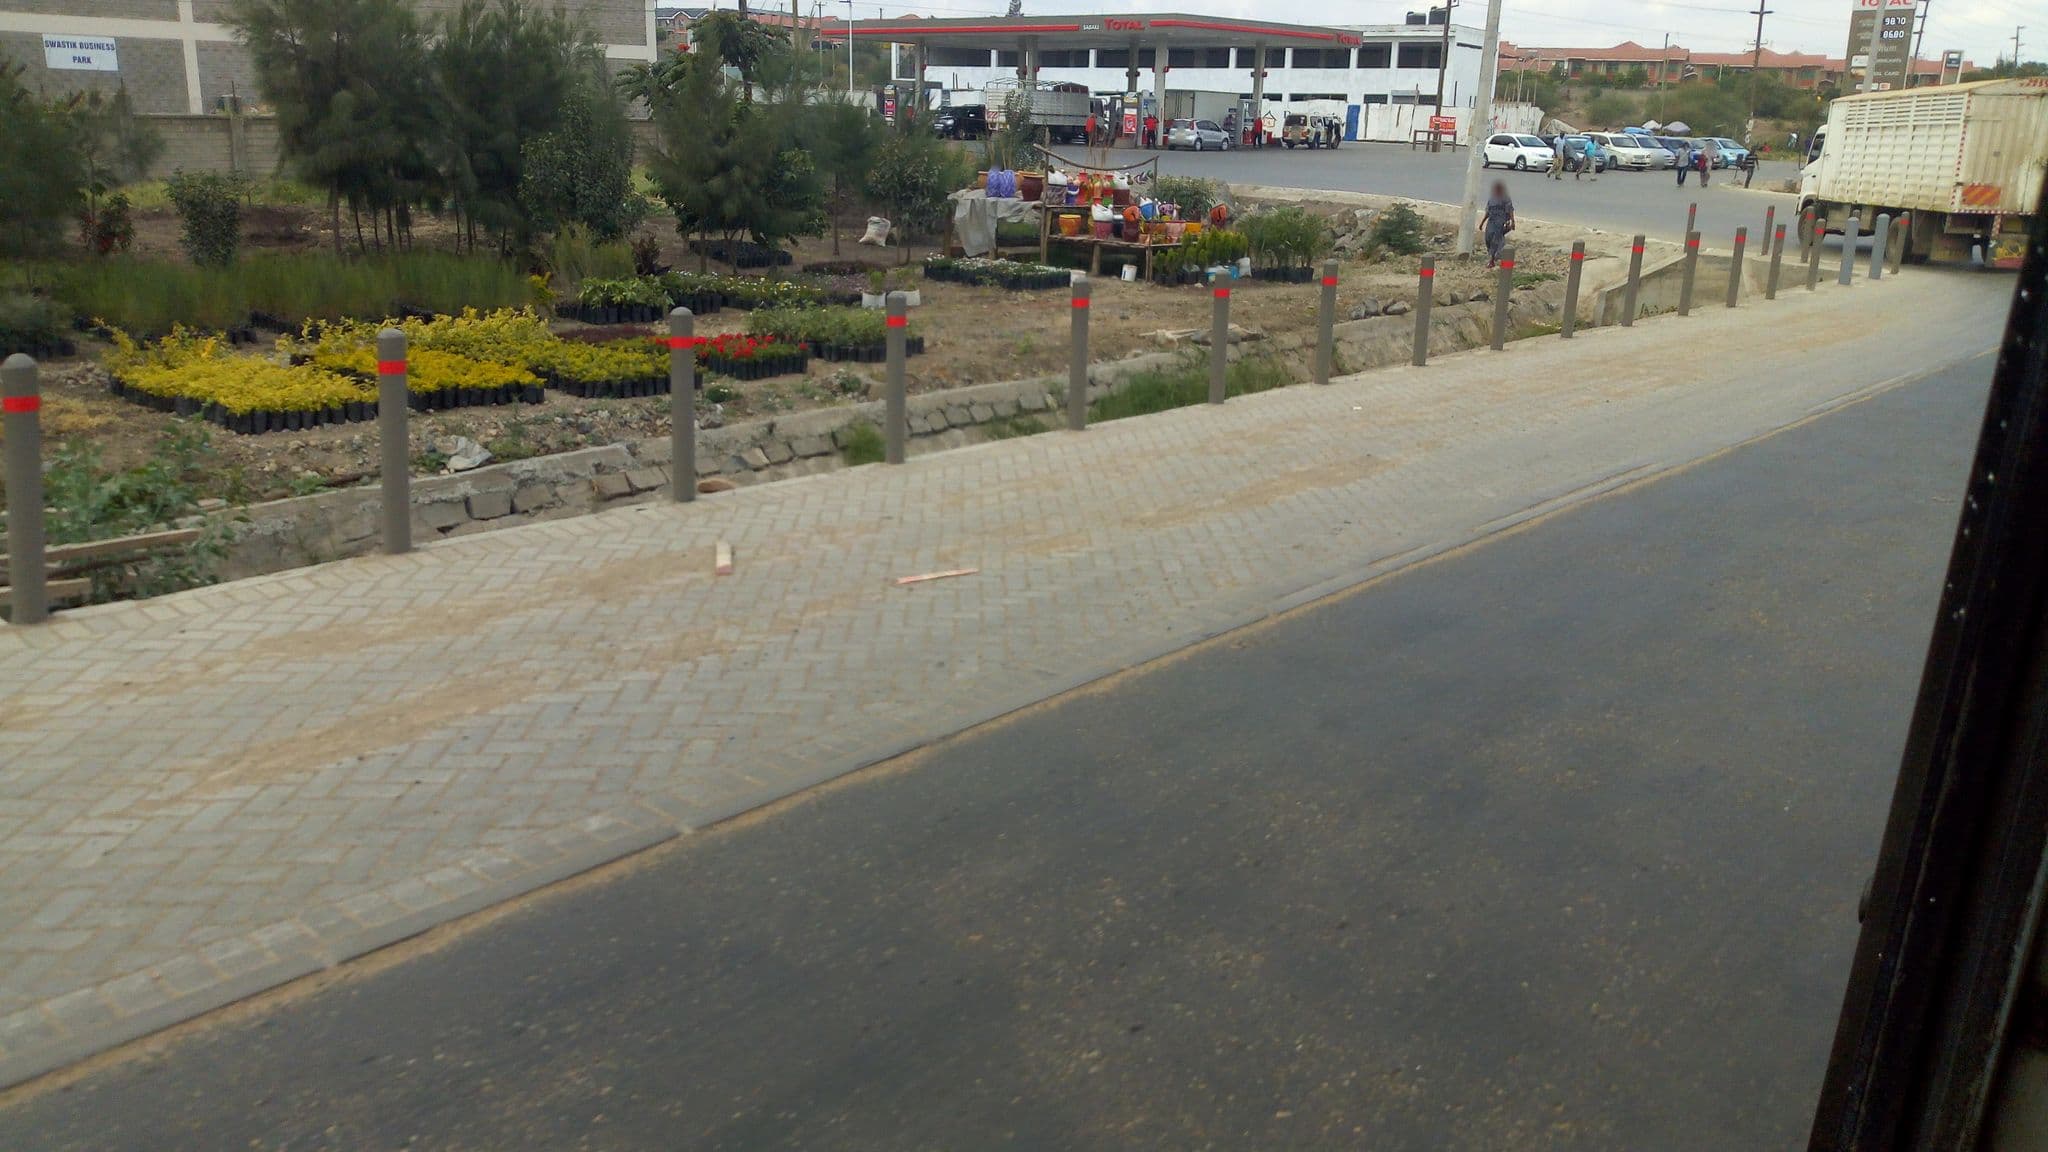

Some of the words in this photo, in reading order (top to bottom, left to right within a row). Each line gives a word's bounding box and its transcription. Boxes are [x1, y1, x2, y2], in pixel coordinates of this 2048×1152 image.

[44, 40, 77, 49] SWASTIK
[79, 42, 116, 51] BUSINESS
[72, 55, 92, 64] PARK
